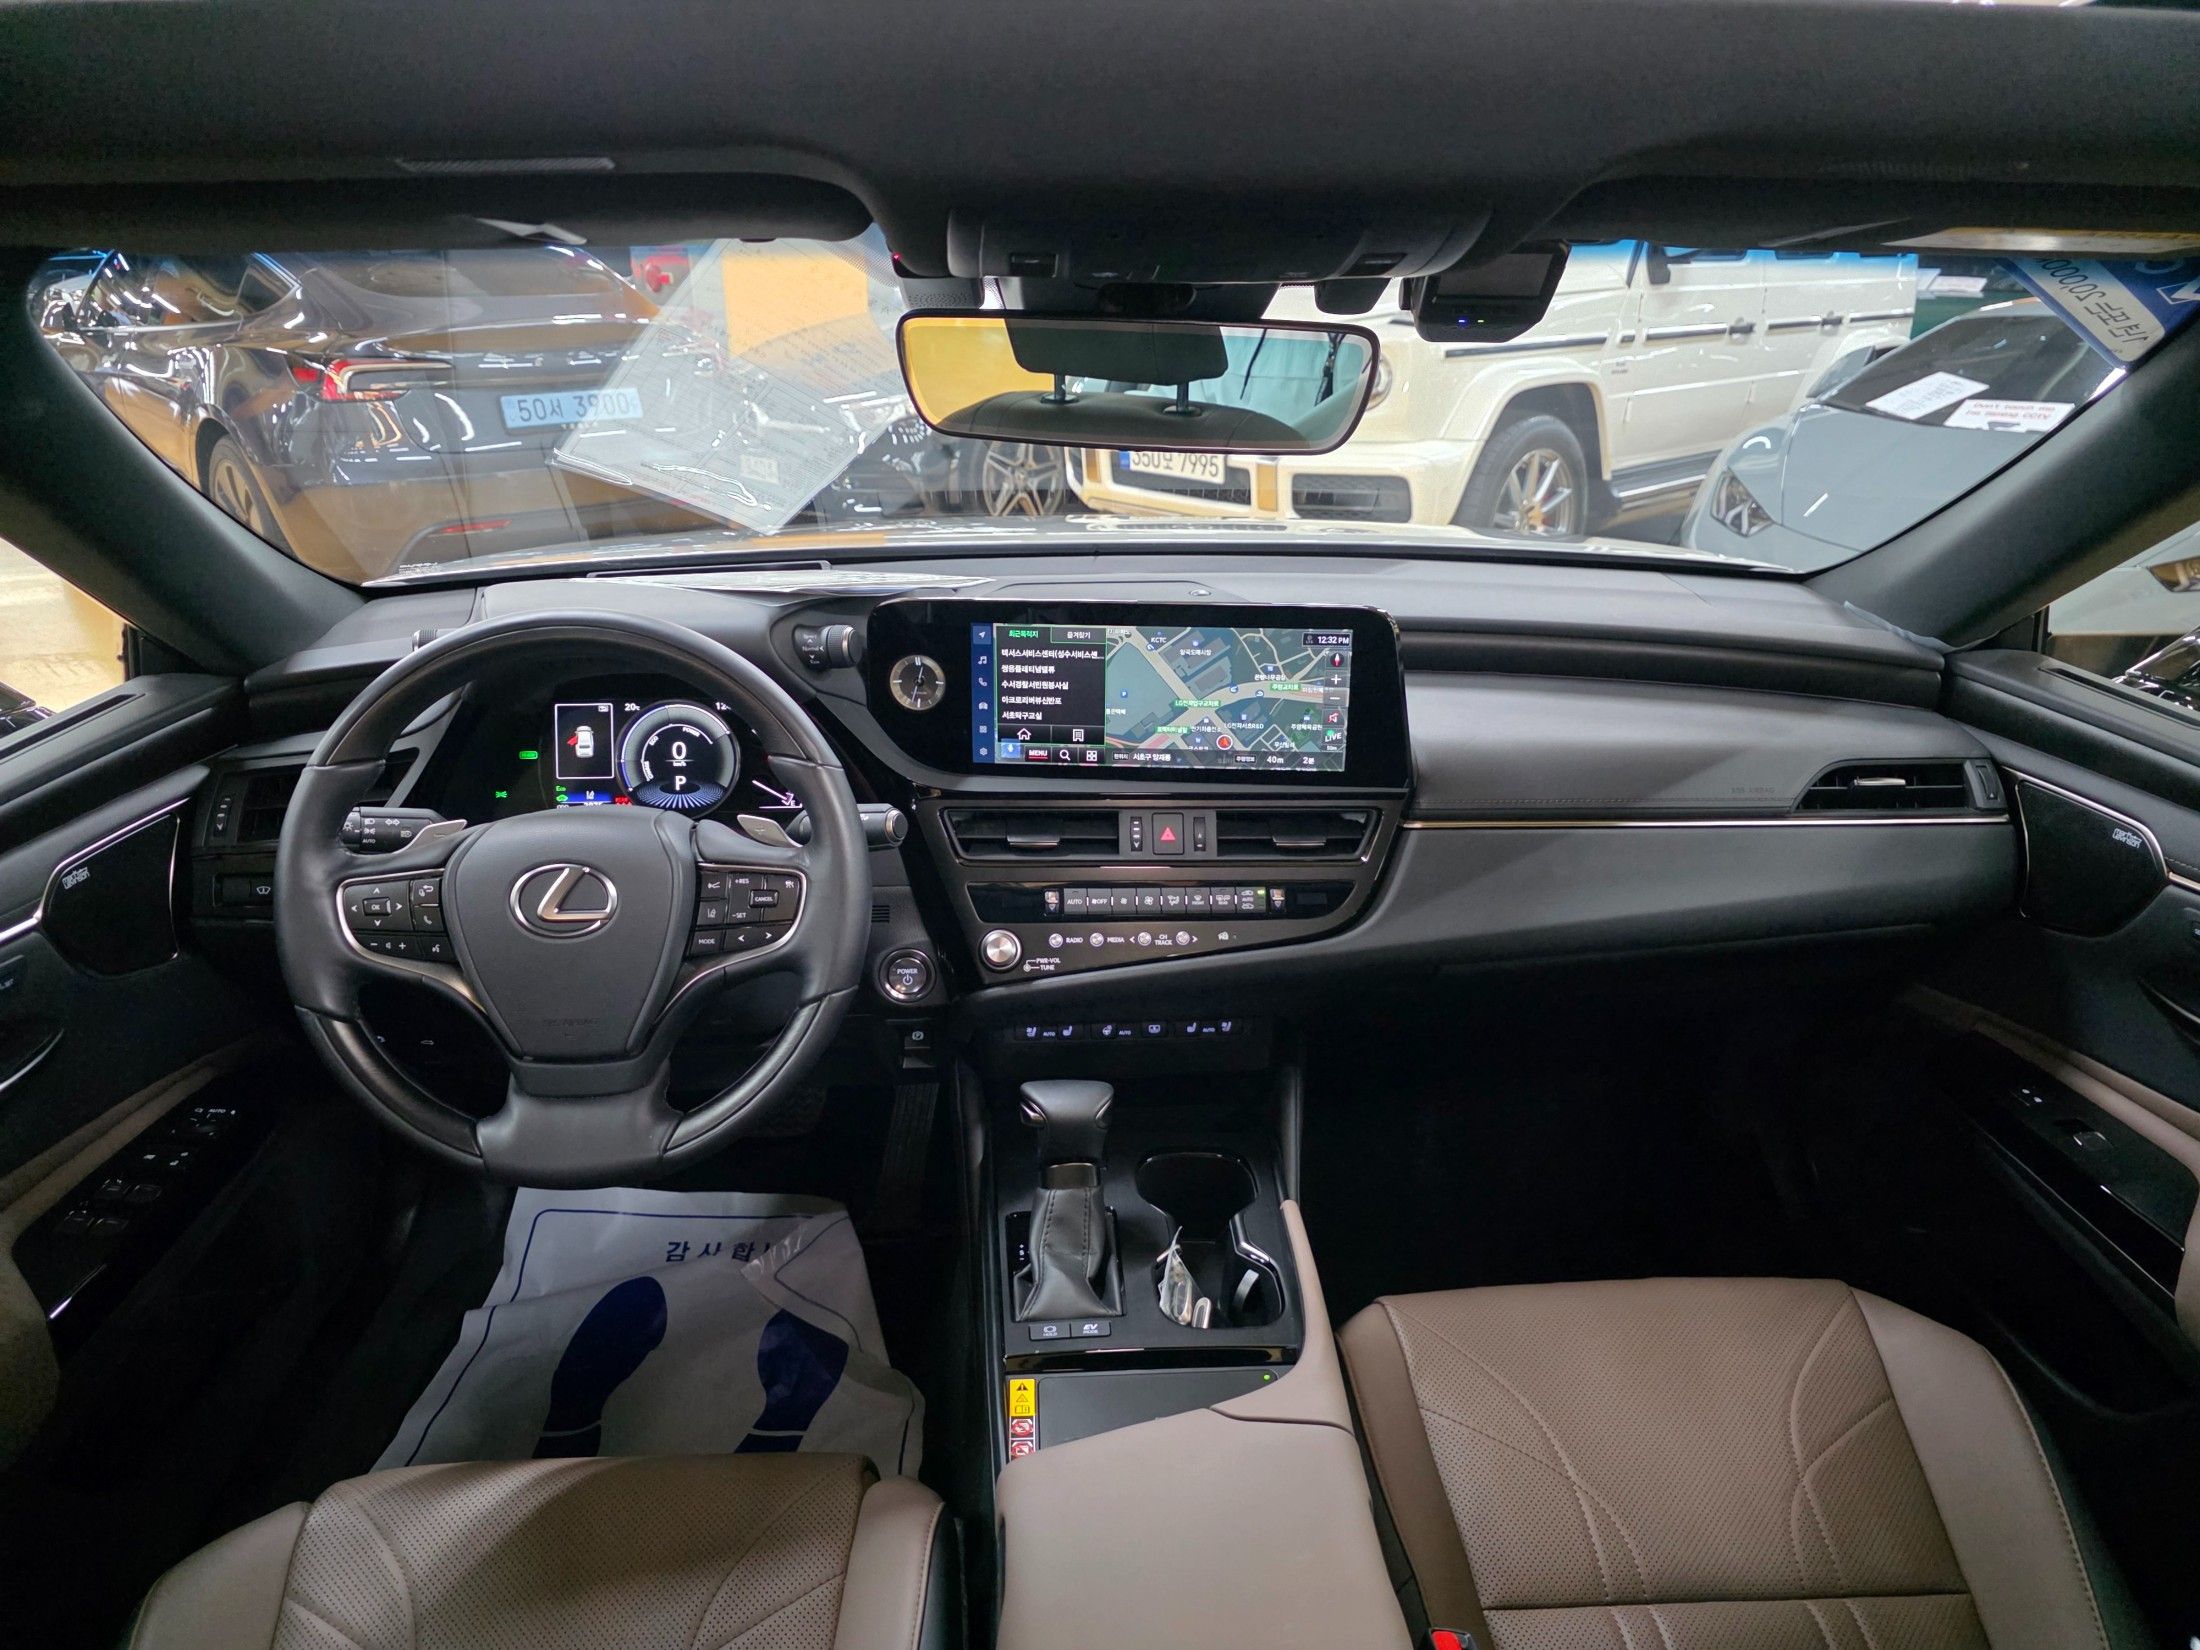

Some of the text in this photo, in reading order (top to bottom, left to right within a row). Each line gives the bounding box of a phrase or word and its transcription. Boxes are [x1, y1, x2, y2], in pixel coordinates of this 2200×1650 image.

[517, 398, 564, 422] 50서
[1178, 454, 1219, 478] 7995
[1317, 636, 1338, 644] 12:32
[671, 741, 687, 761] 0
[1267, 755, 1284, 764] 40m
[675, 775, 687, 791] P
